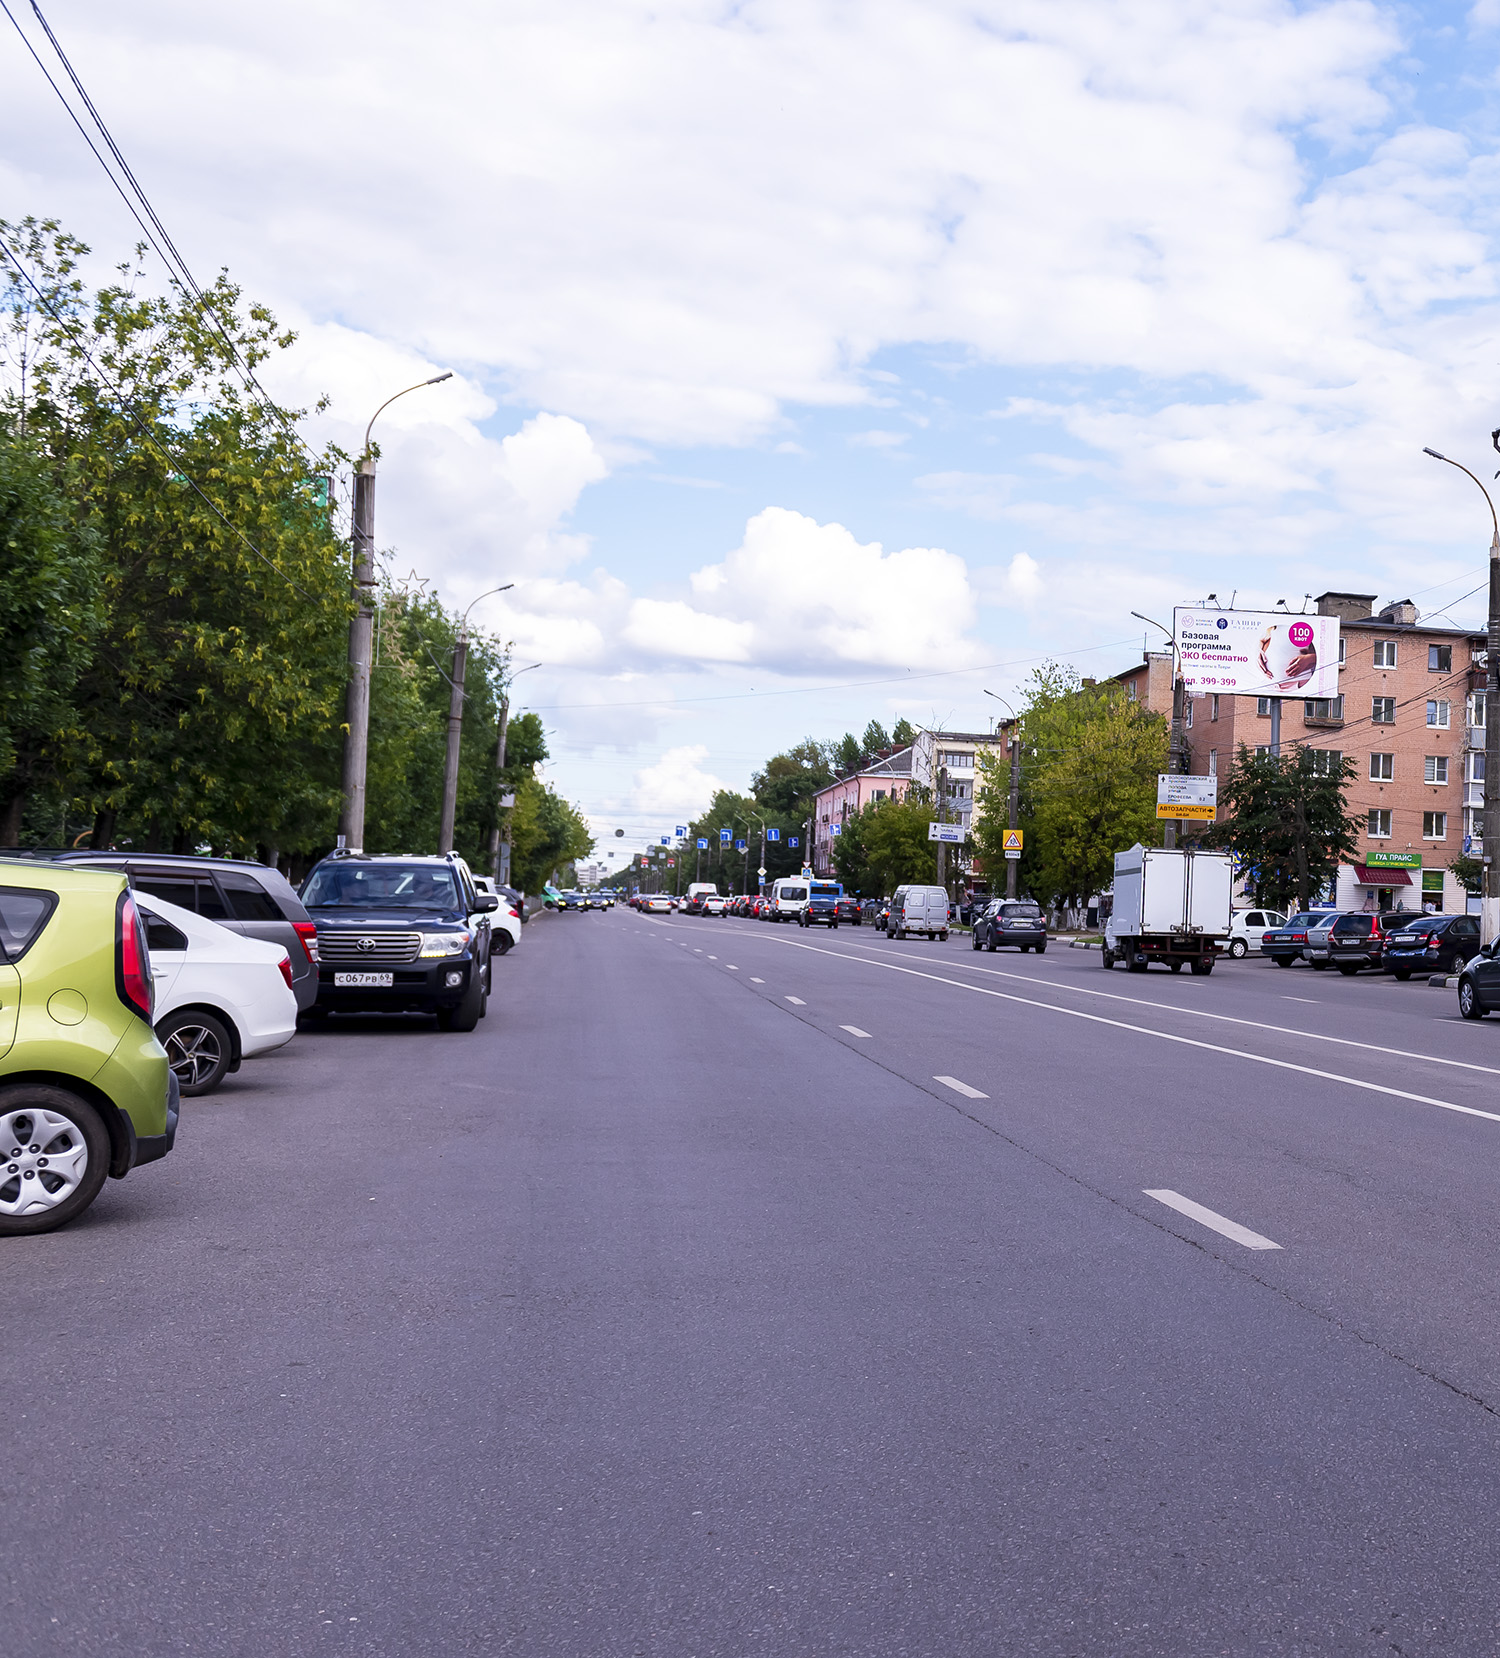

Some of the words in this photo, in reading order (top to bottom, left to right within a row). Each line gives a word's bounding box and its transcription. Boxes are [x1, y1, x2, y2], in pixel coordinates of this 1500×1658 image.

[1181, 631, 1220, 641] Базовая
[1292, 627, 1310, 637] 100
[1181, 642, 1232, 652] программа
[1181, 651, 1200, 660] ЭКО
[1201, 652, 1249, 663] бесплатно
[1200, 676, 1237, 687] 399-399
[1389, 853, 1413, 862] ПРАЙС
